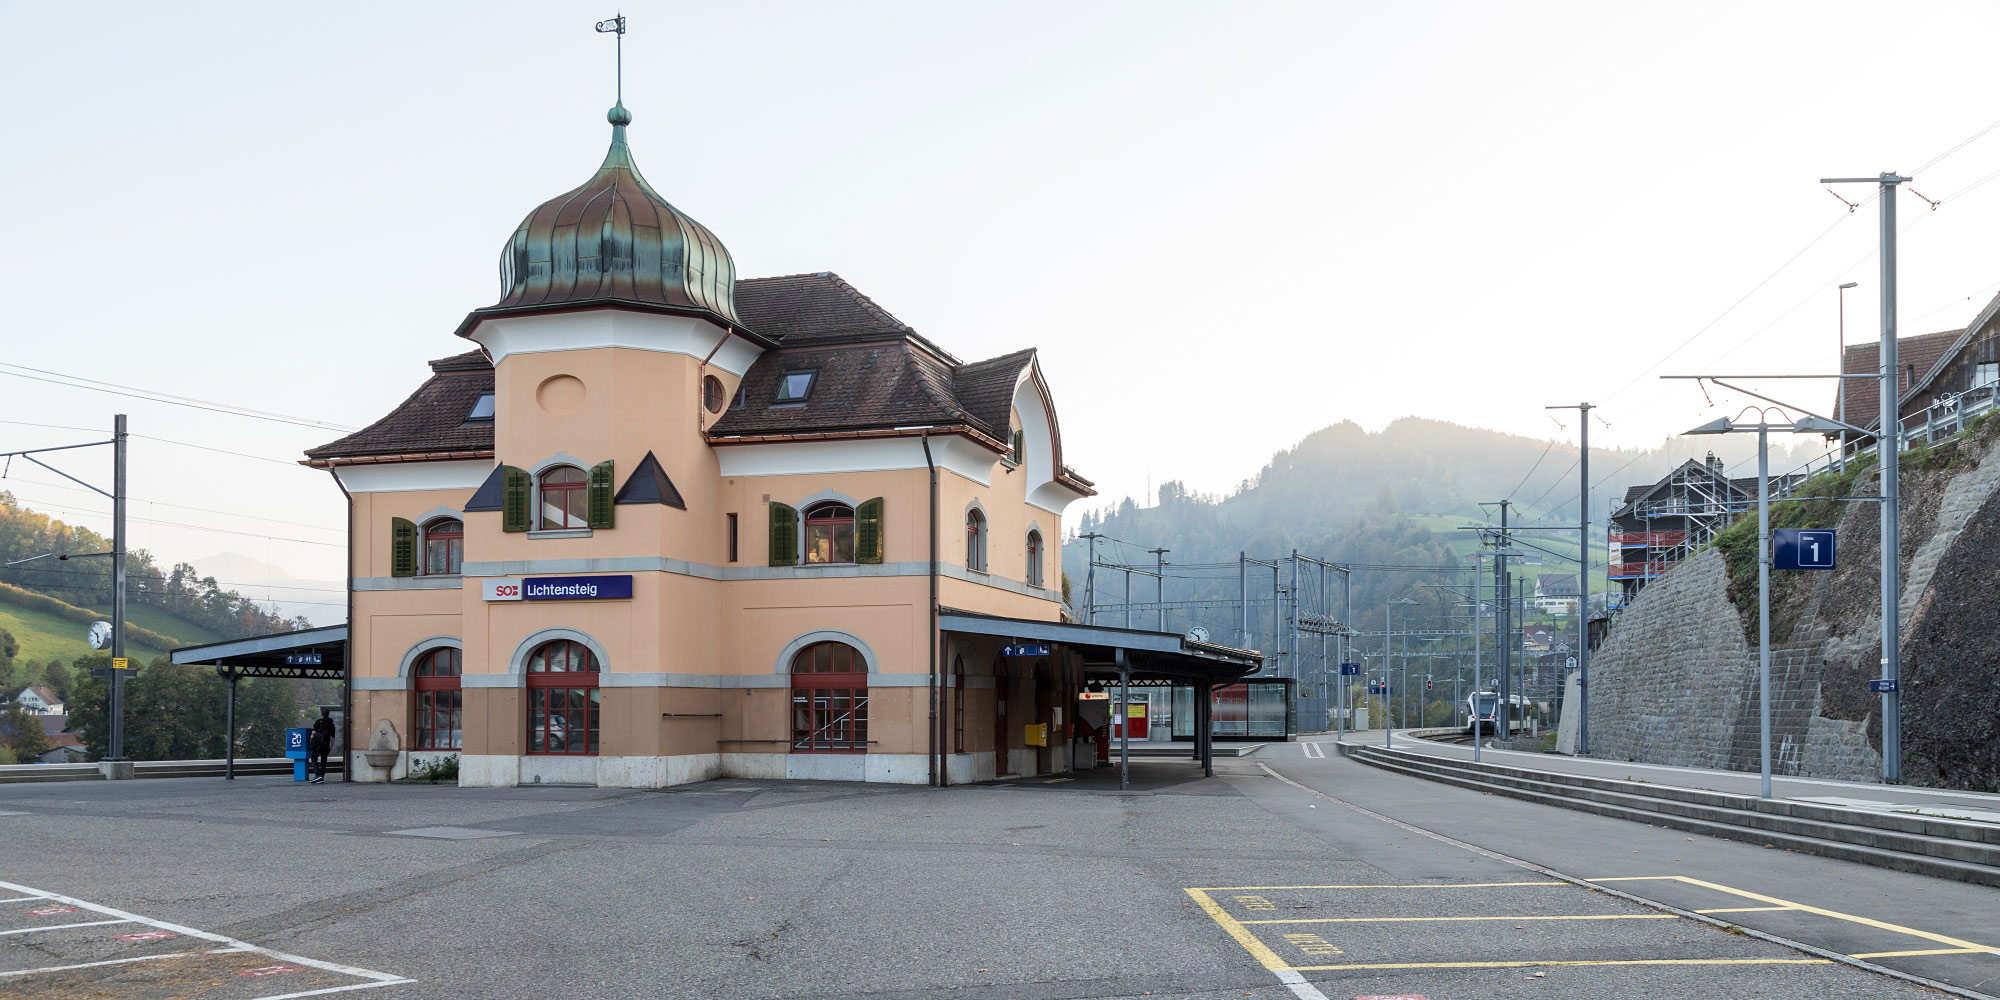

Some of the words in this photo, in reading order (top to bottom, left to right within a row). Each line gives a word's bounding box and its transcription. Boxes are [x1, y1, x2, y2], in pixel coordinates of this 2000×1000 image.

[1810, 542, 1819, 562] 1
[527, 583, 598, 597] Lichtensteig
[1351, 666, 1356, 674] 1
[291, 732, 302, 745] 20
